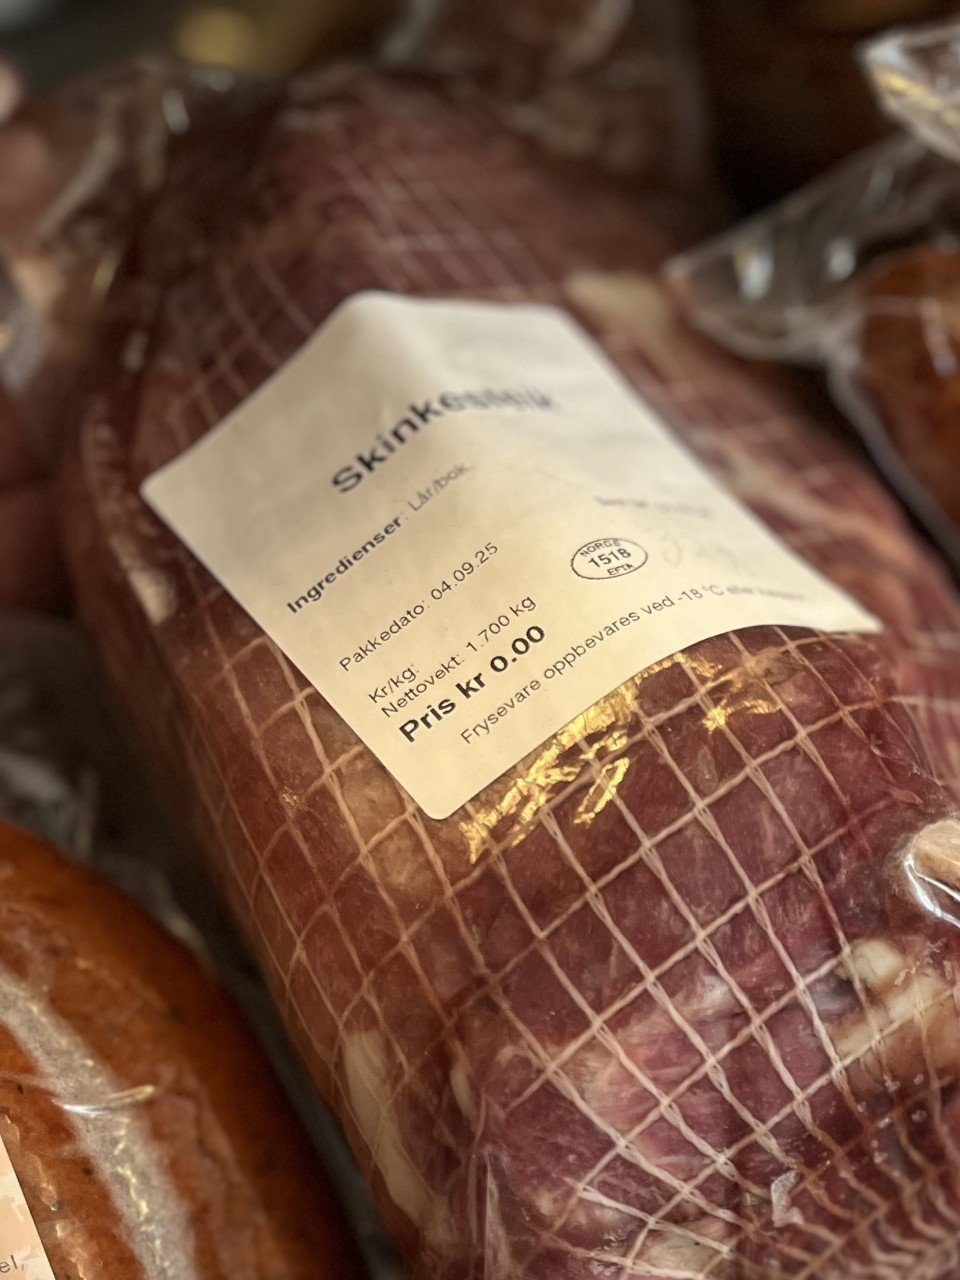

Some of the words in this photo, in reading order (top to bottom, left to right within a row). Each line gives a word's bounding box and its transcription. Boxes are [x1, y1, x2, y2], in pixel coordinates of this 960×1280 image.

[579, 540, 621, 558] NORGE
[588, 547, 632, 568] 1518
[607, 562, 634, 576] EFTA
[339, 600, 431, 672] Pakkedato:
[430, 541, 499, 601] 04.09.25
[368, 663, 420, 704] Kr/kg:
[381, 653, 466, 718] Nettovekt:
[465, 614, 511, 652] 1.700
[509, 595, 537, 617] kg
[398, 697, 457, 743] Pris
[455, 671, 487, 700] kr
[489, 624, 546, 674] 0.00
[459, 679, 542, 745] Frysevare
[543, 609, 641, 681] oppbevares
[640, 595, 676, 615] ved
[677, 587, 704, 602] -18
